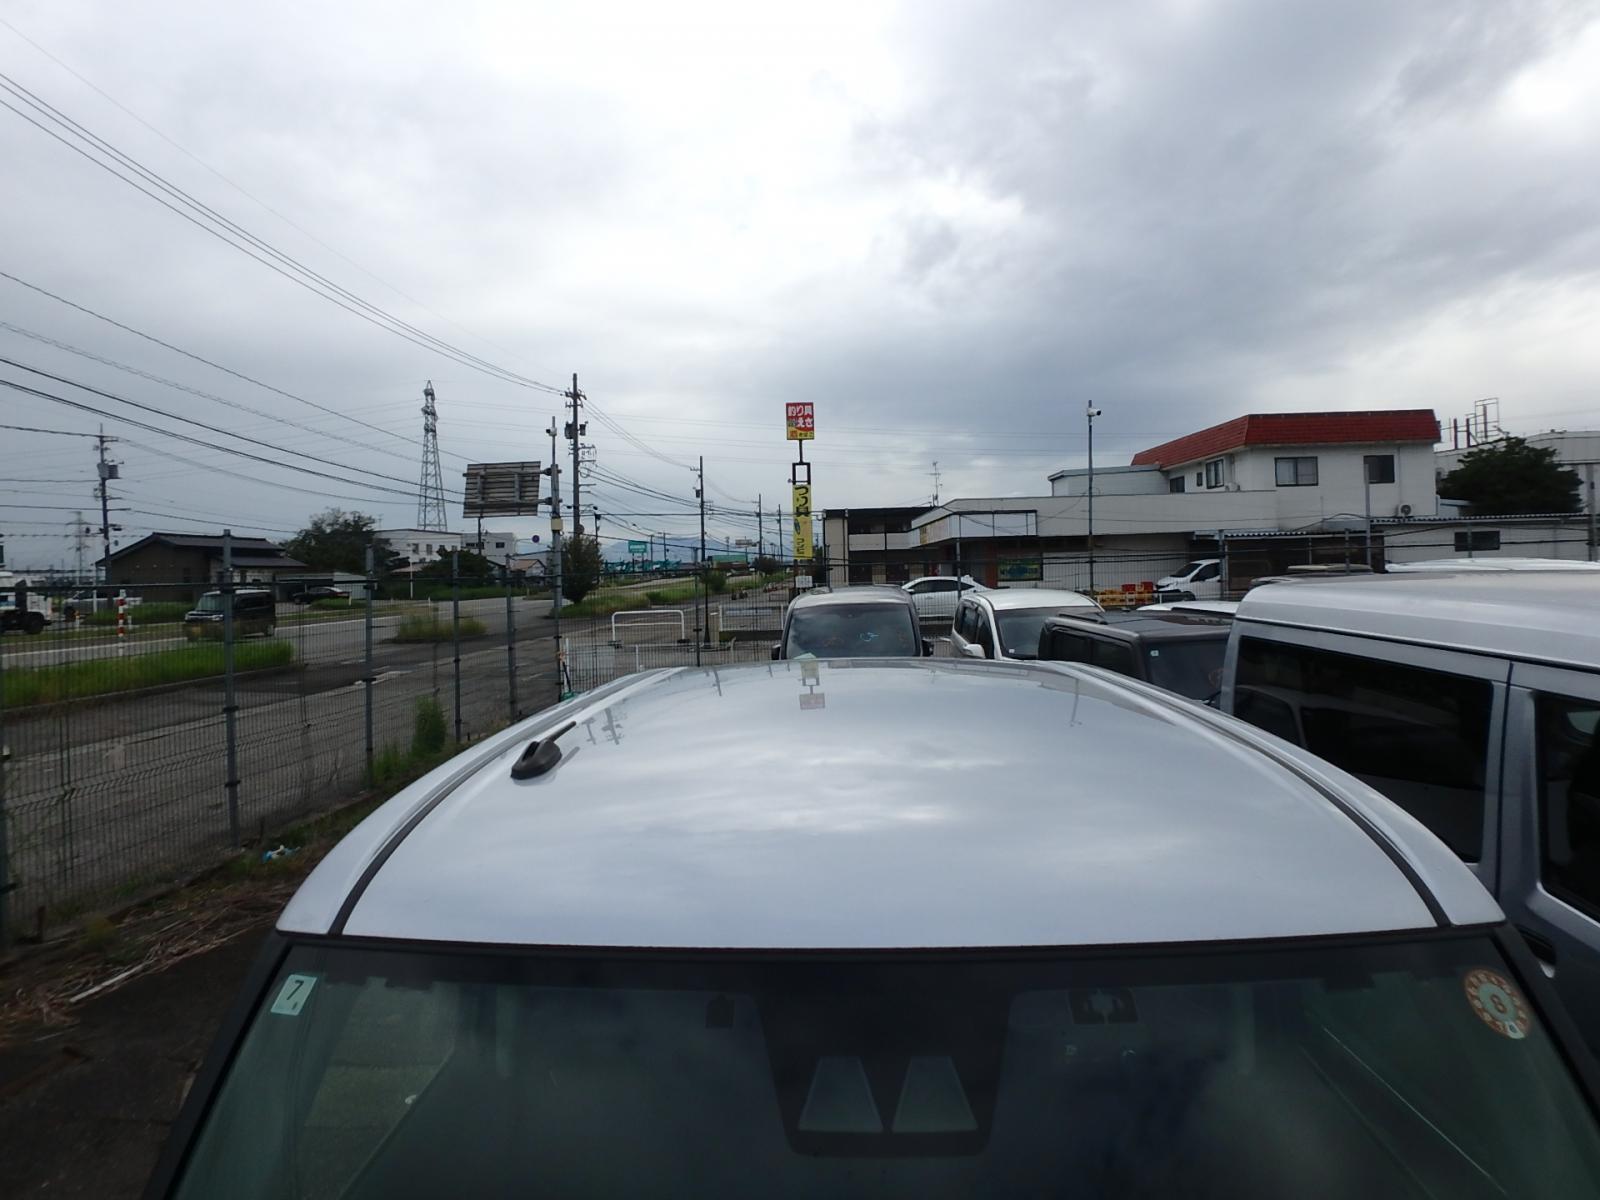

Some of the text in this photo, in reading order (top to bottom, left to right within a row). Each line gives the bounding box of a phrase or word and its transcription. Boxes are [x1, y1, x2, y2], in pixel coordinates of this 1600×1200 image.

[788, 404, 812, 417] 釣り具
[796, 417, 813, 428] えさ
[795, 486, 809, 517] つり具
[286, 980, 305, 1000] 7
